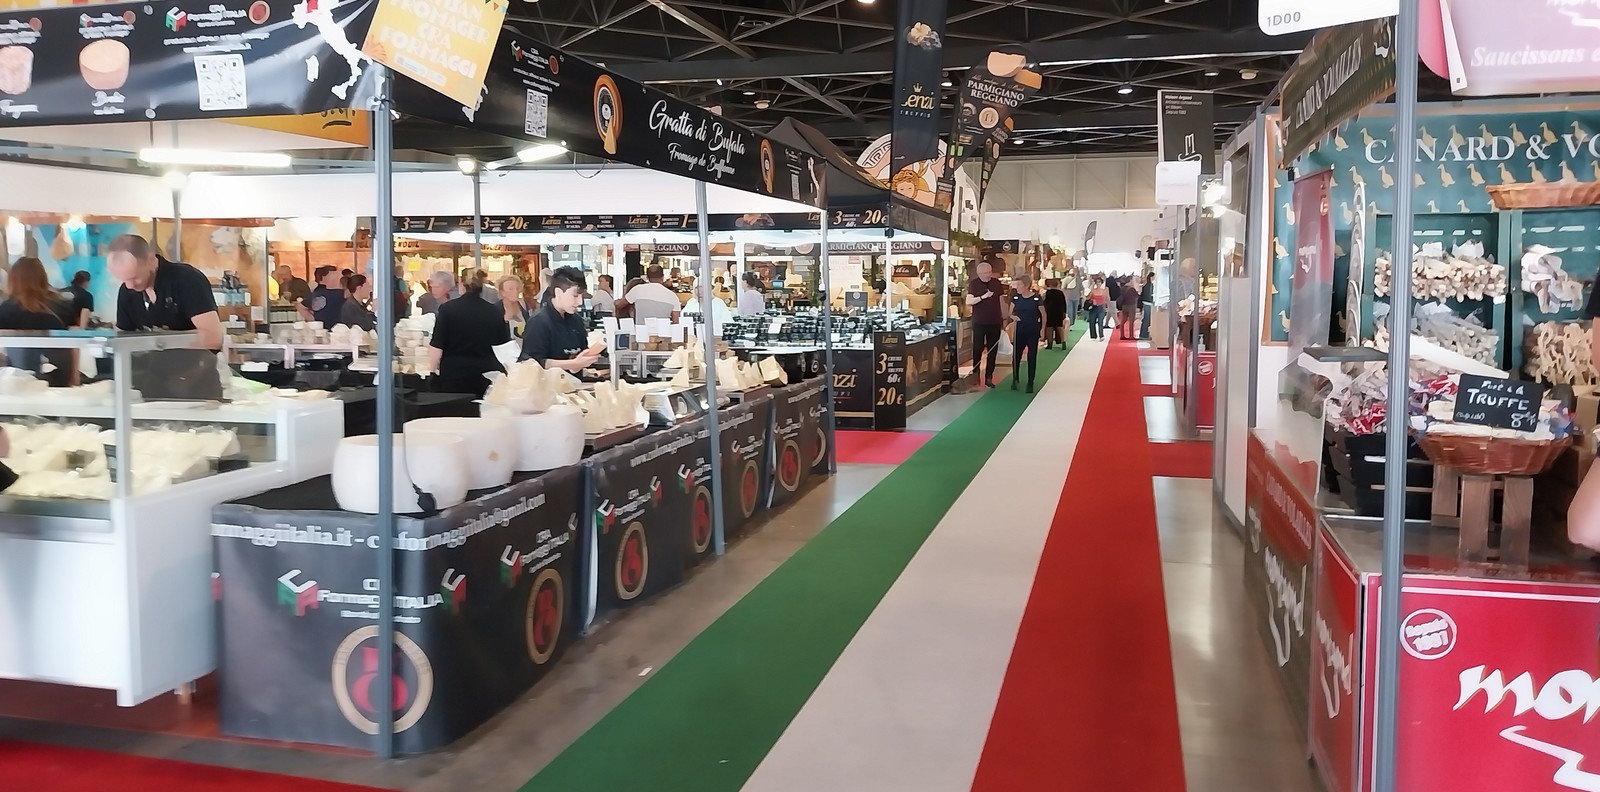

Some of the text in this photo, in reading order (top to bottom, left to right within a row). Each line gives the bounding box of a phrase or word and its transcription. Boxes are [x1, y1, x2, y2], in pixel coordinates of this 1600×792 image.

[1266, 11, 1301, 28] 1D00
[380, 25, 477, 79] FORMAGGI
[1471, 44, 1587, 67] Saucissons
[967, 79, 1025, 101] PARMIGIANO
[970, 89, 1018, 108] REGGIANO
[649, 99, 695, 139] Gratta
[695, 119, 708, 142] di
[708, 122, 746, 163] Bufala
[667, 142, 699, 171] Fromage
[1526, 134, 1551, 160] &
[401, 216, 411, 231] 3
[427, 216, 436, 231] 1
[481, 216, 490, 230] 3
[507, 216, 530, 230] 20€
[652, 214, 662, 229] 3
[680, 214, 689, 228] 1
[833, 210, 843, 225] 3
[862, 209, 889, 225] 20€
[876, 352, 888, 375] 3
[876, 386, 904, 406] 20€
[1466, 387, 1530, 411] TRUFFE
